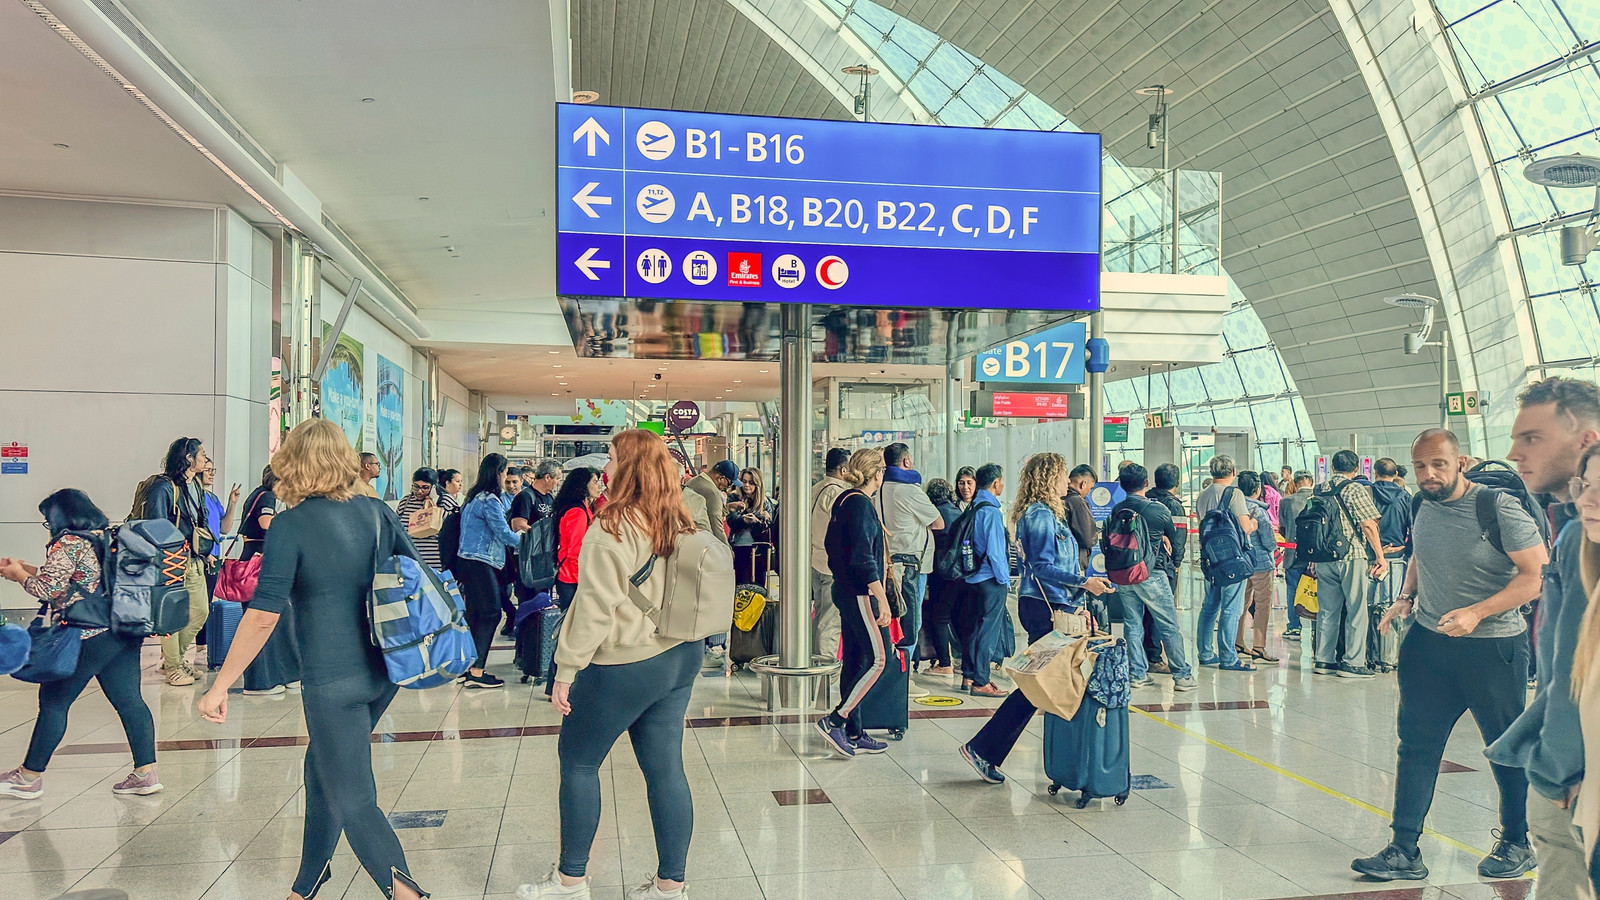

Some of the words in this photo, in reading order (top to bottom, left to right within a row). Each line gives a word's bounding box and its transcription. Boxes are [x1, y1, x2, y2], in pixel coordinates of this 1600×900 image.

[686, 192, 723, 227] A,
[731, 194, 795, 231] B18,
[803, 197, 869, 234] B20,
[877, 200, 945, 237] B22,
[951, 204, 980, 238] C,
[987, 205, 1015, 239] D,
[1022, 206, 1039, 235] F
[791, 260, 797, 268] B
[731, 272, 759, 280] Emirates
[1005, 340, 1075, 379] B17
